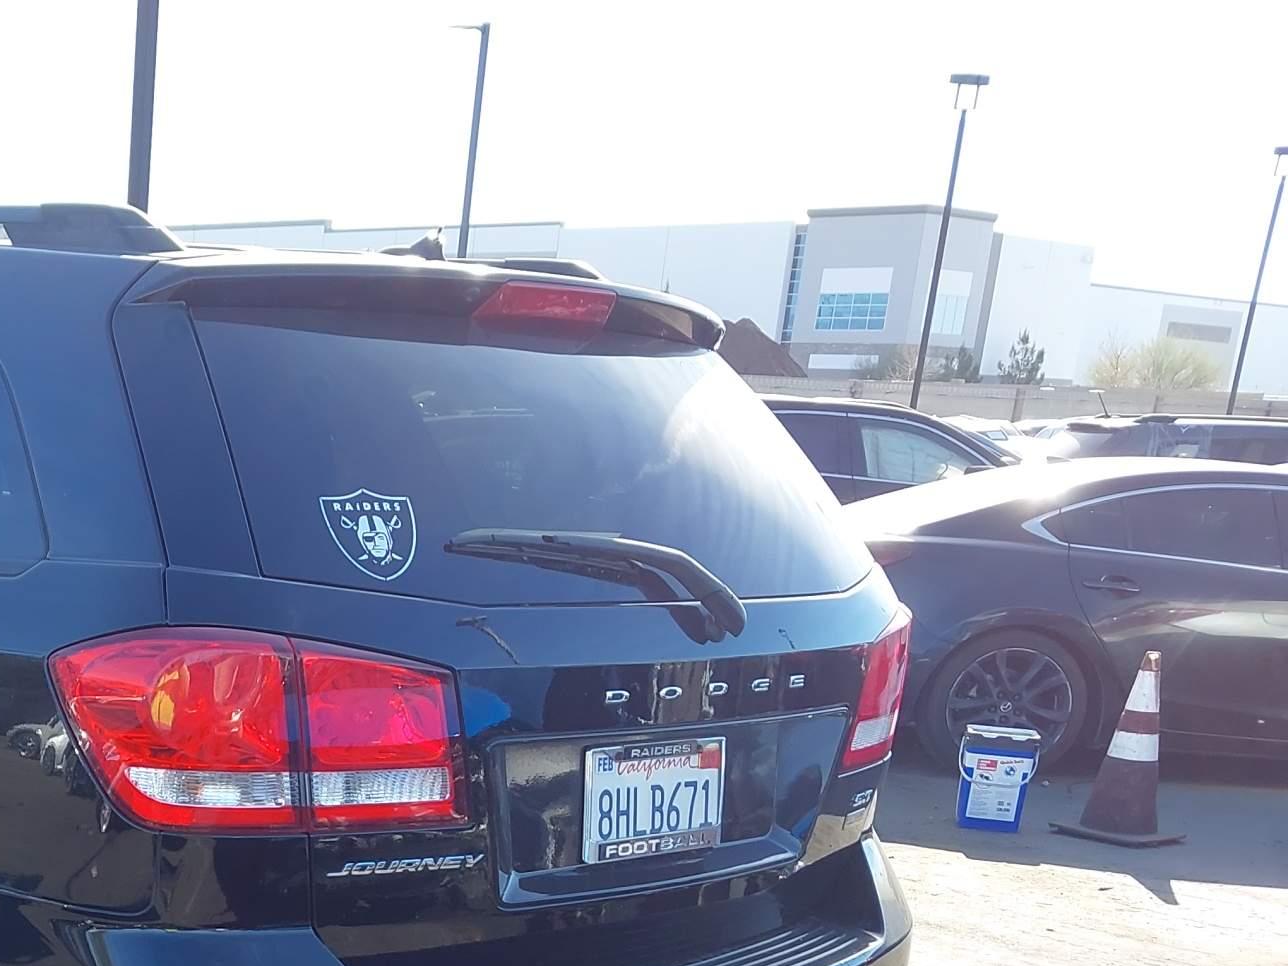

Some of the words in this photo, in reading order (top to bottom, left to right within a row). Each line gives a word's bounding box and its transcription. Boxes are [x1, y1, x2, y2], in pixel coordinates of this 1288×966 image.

[332, 502, 401, 511] RAIDERS
[605, 674, 805, 704] DODGE
[631, 744, 691, 758] RAIDERS
[598, 757, 613, 772] FEB
[617, 756, 697, 780] California
[598, 778, 713, 841] 8HLB671
[326, 854, 485, 878] JOURNEY
